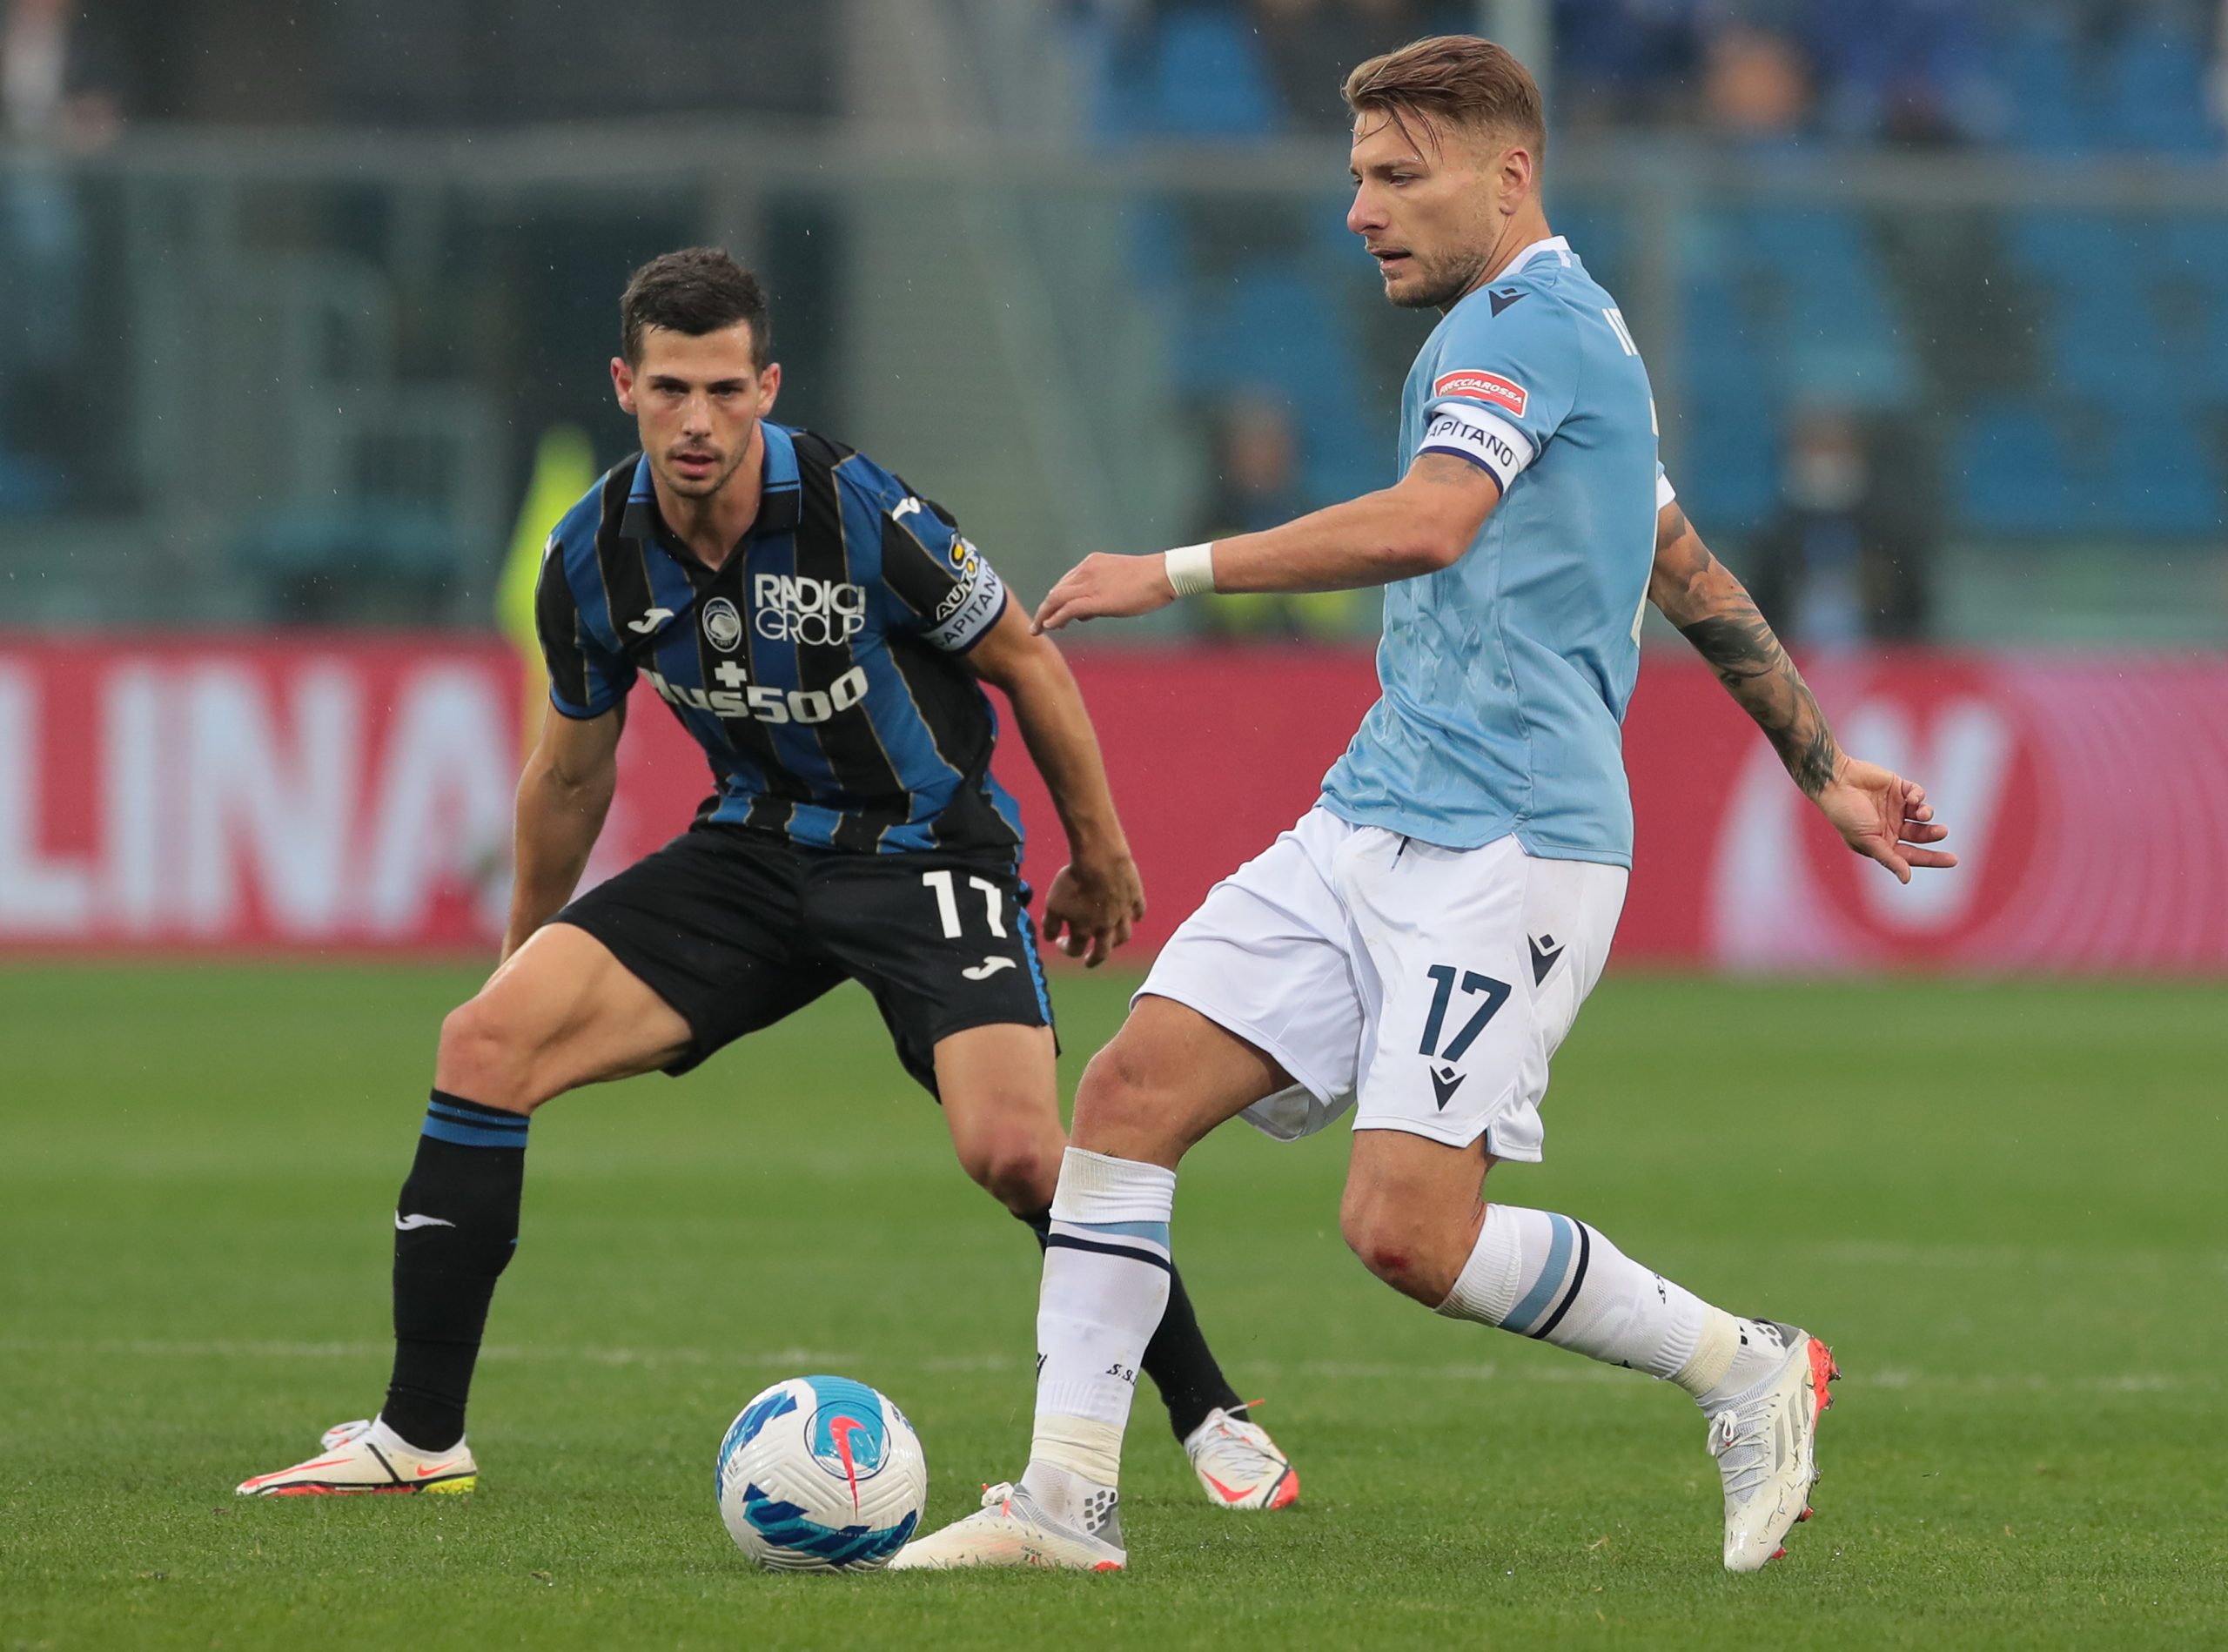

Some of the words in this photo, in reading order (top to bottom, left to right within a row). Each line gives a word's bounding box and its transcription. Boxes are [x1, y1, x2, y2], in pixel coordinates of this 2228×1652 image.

[1428, 420, 1513, 467] APITANO
[755, 574, 866, 614] RADICI
[755, 607, 865, 646] GROUP
[638, 666, 869, 724] lus500
[923, 870, 1007, 938] 11
[1419, 964, 1512, 1062] 17
